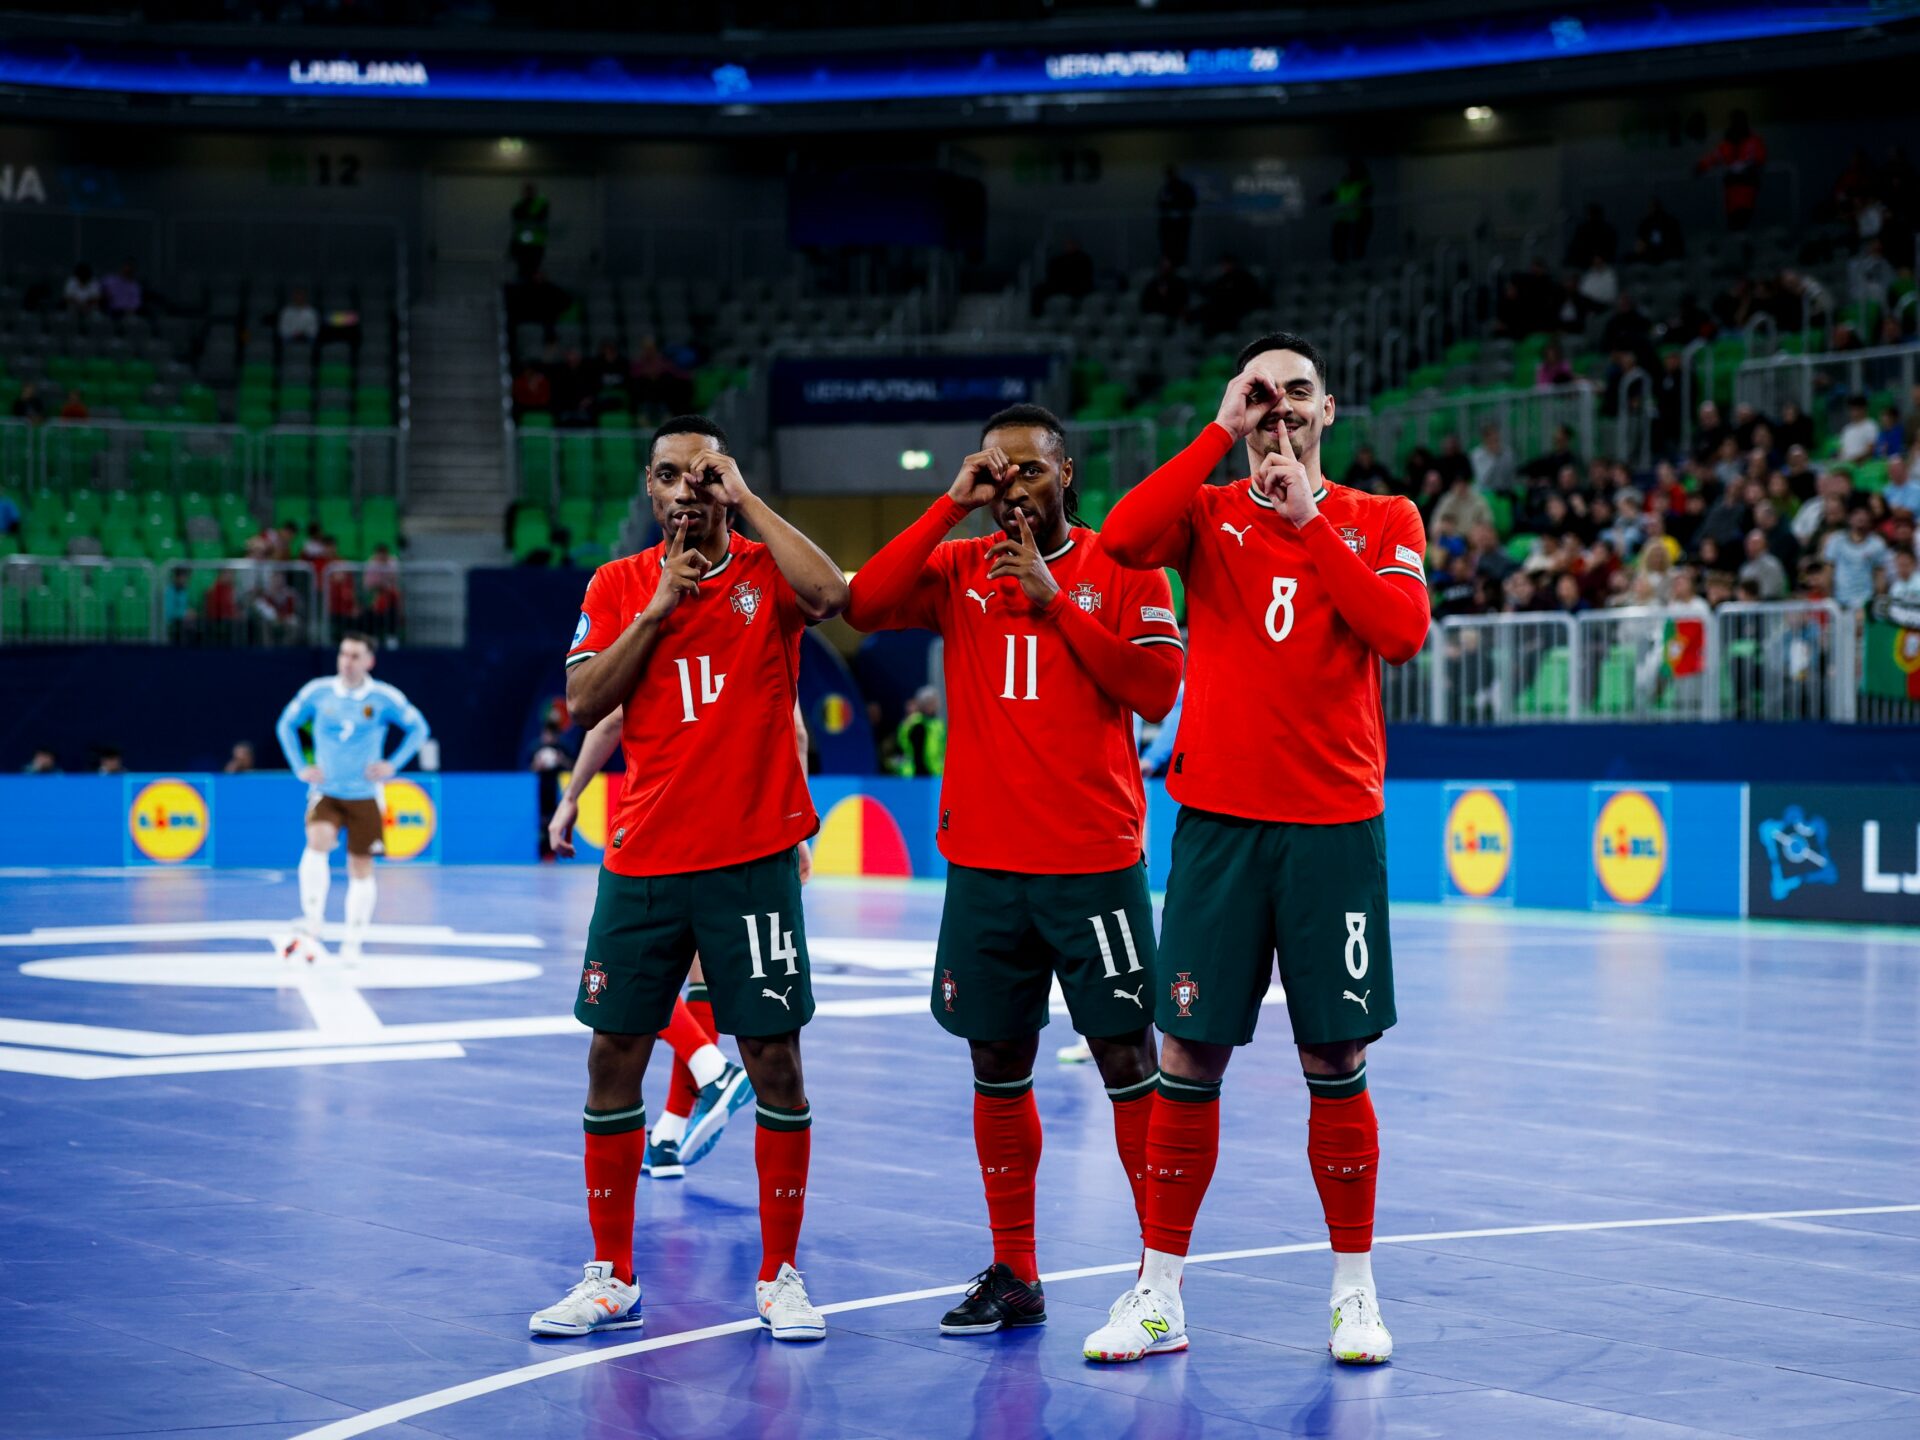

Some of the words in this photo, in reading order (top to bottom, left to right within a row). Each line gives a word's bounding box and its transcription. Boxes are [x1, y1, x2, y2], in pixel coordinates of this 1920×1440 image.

[289, 60, 428, 86] LJUBLJANA
[1264, 576, 1298, 642] 8
[1000, 634, 1040, 700] 11
[383, 804, 424, 830] IDL
[741, 912, 800, 979] 14
[1087, 909, 1144, 979] 11
[1343, 912, 1370, 980] 8
